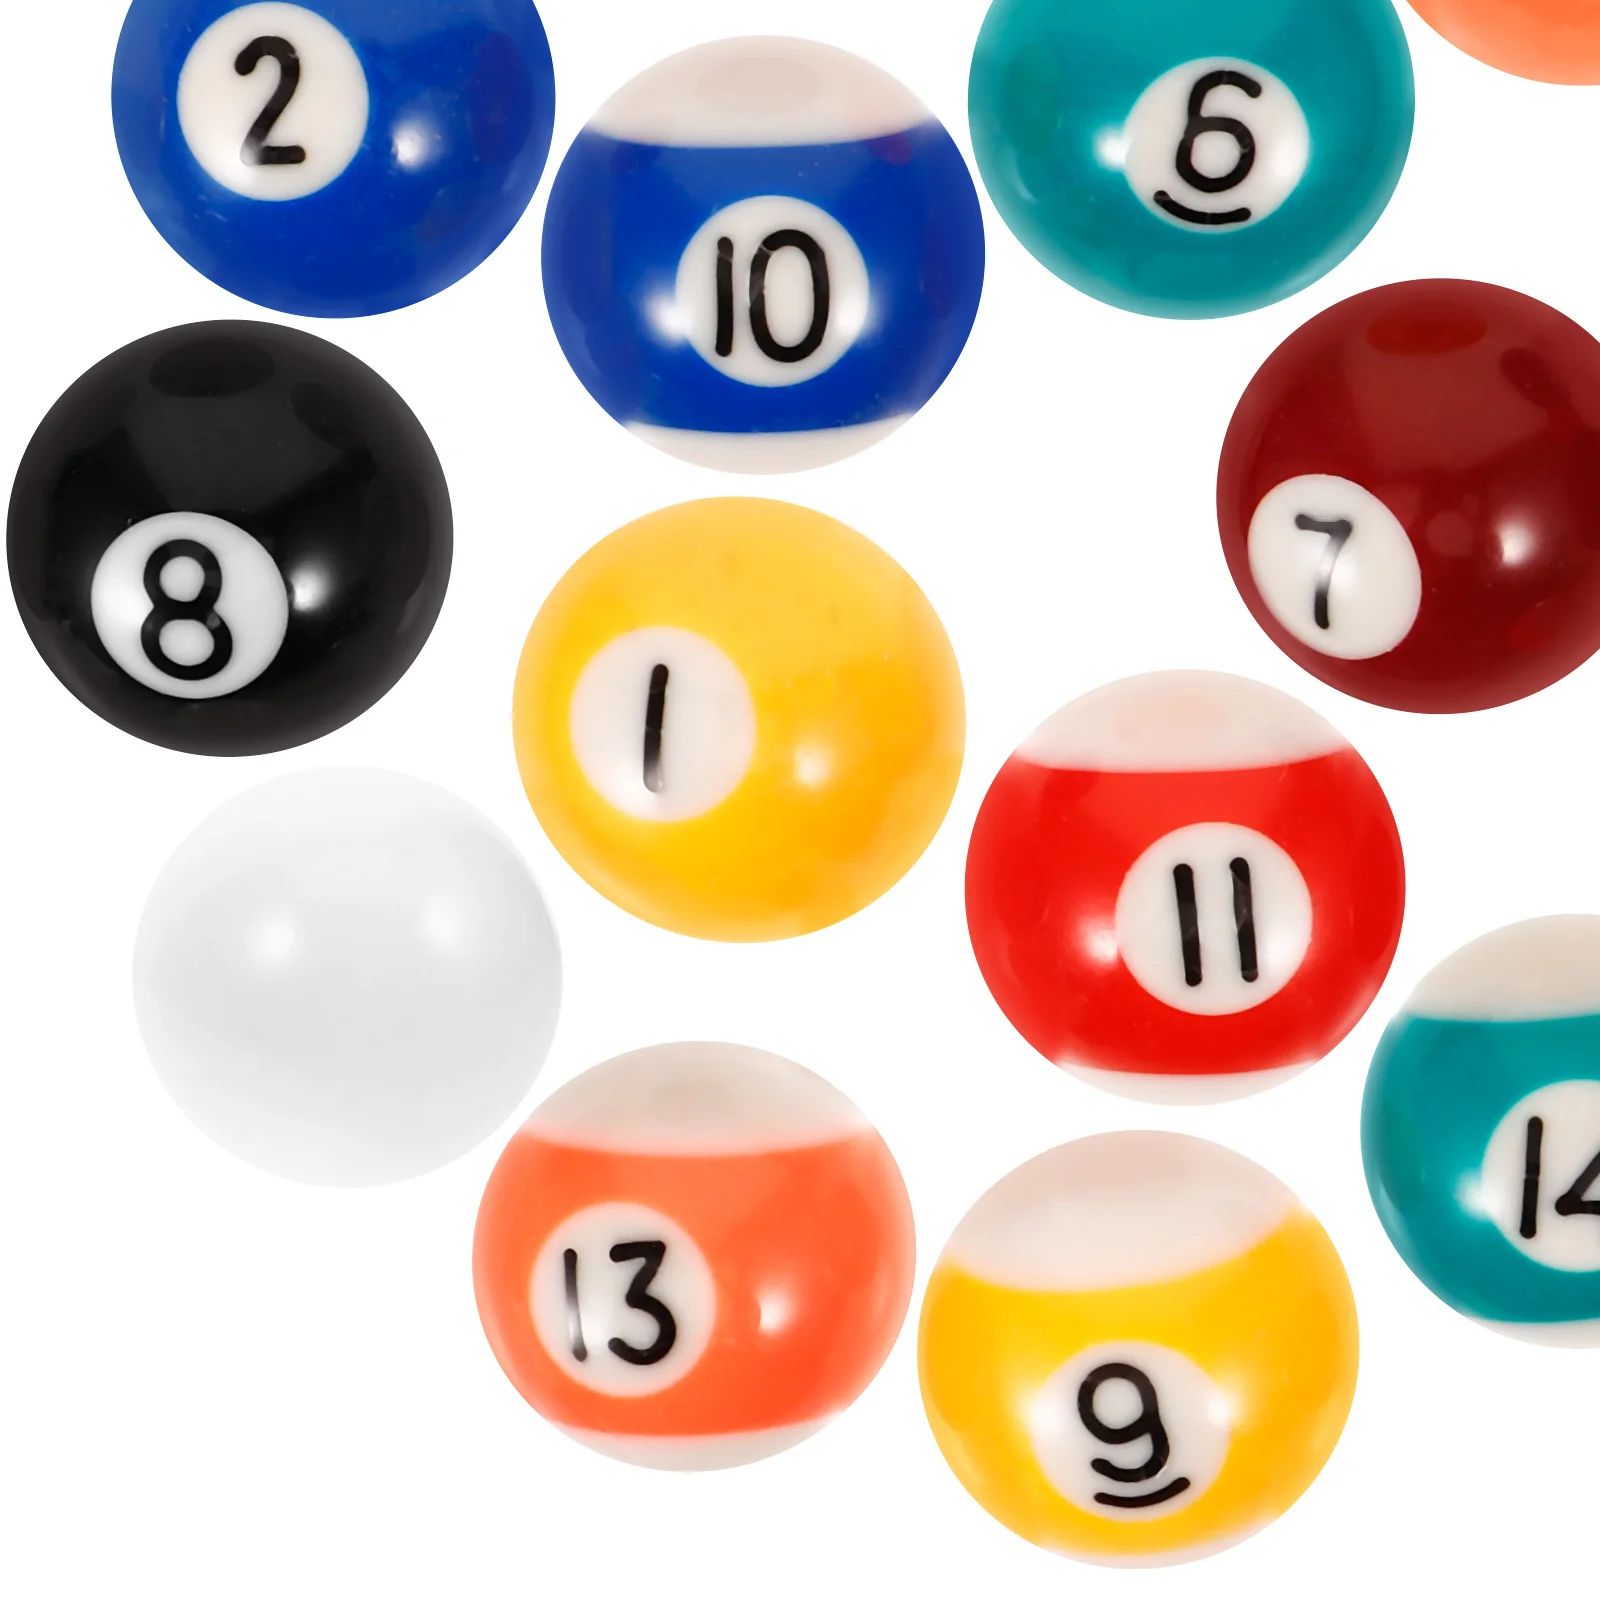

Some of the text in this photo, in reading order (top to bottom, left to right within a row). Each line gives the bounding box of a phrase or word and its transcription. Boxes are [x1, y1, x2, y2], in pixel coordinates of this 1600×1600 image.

[234, 35, 306, 166] 2
[1154, 69, 1262, 226] 6
[714, 228, 831, 364] 10
[141, 539, 234, 682] 8
[1294, 512, 1353, 630] 7
[643, 663, 669, 793] 1
[1171, 856, 1259, 988] 11
[562, 1240, 677, 1367] 13
[1078, 1362, 1190, 1509] 9
